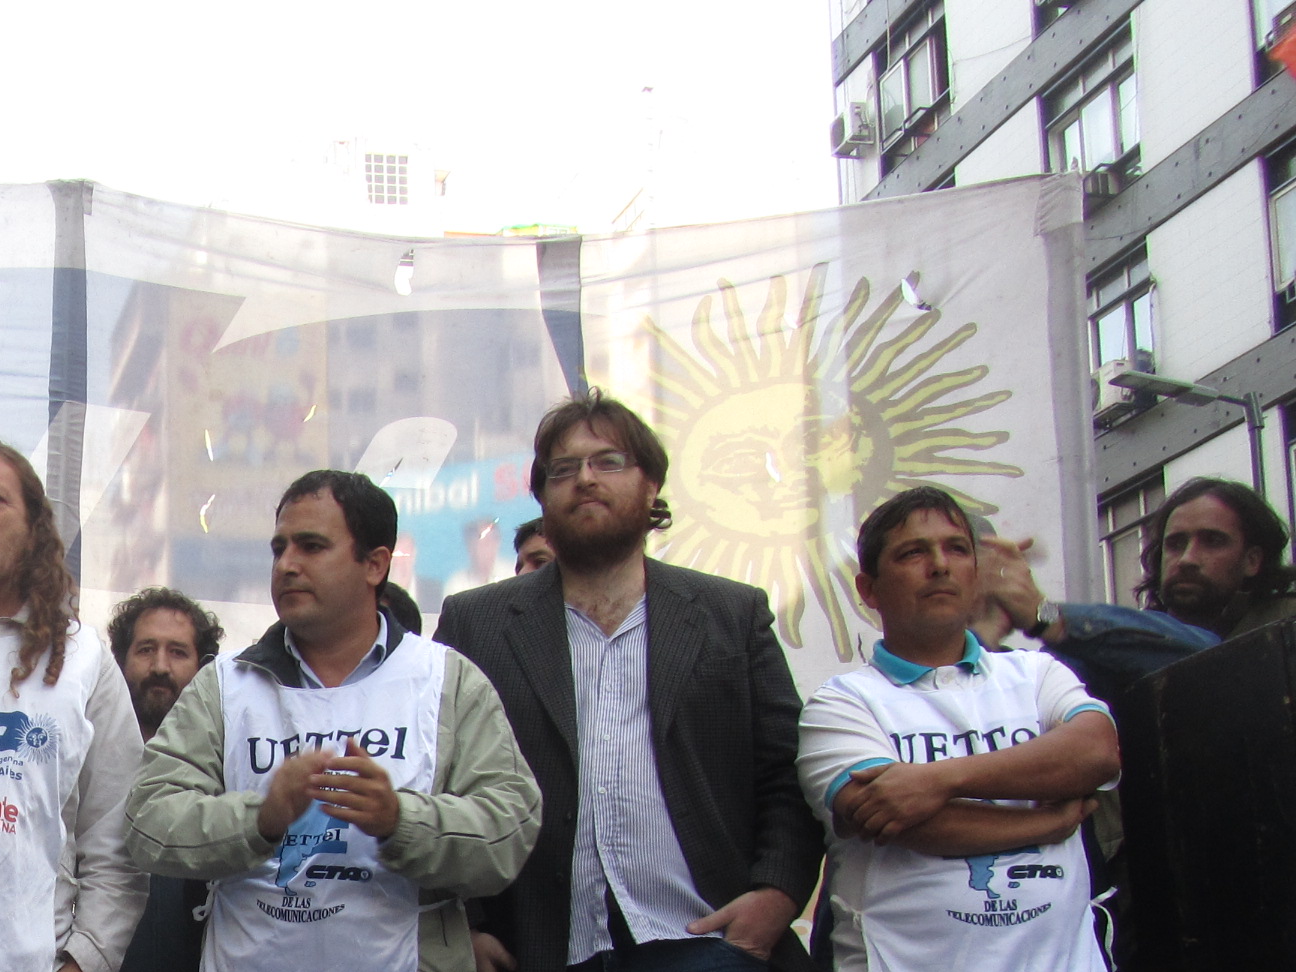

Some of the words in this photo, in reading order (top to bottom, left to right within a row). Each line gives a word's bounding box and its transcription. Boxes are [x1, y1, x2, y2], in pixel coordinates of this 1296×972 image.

[285, 829, 341, 847] ETTel
[306, 865, 364, 881] CTA
[1007, 865, 1055, 879] CTA
[282, 897, 295, 908] DE
[295, 897, 311, 909] LAS
[984, 900, 998, 912] DE
[999, 899, 1017, 911] LAS
[256, 900, 345, 923] TELECOMUNICACIONES
[946, 902, 1051, 927] TELECOMUNICACIONES
